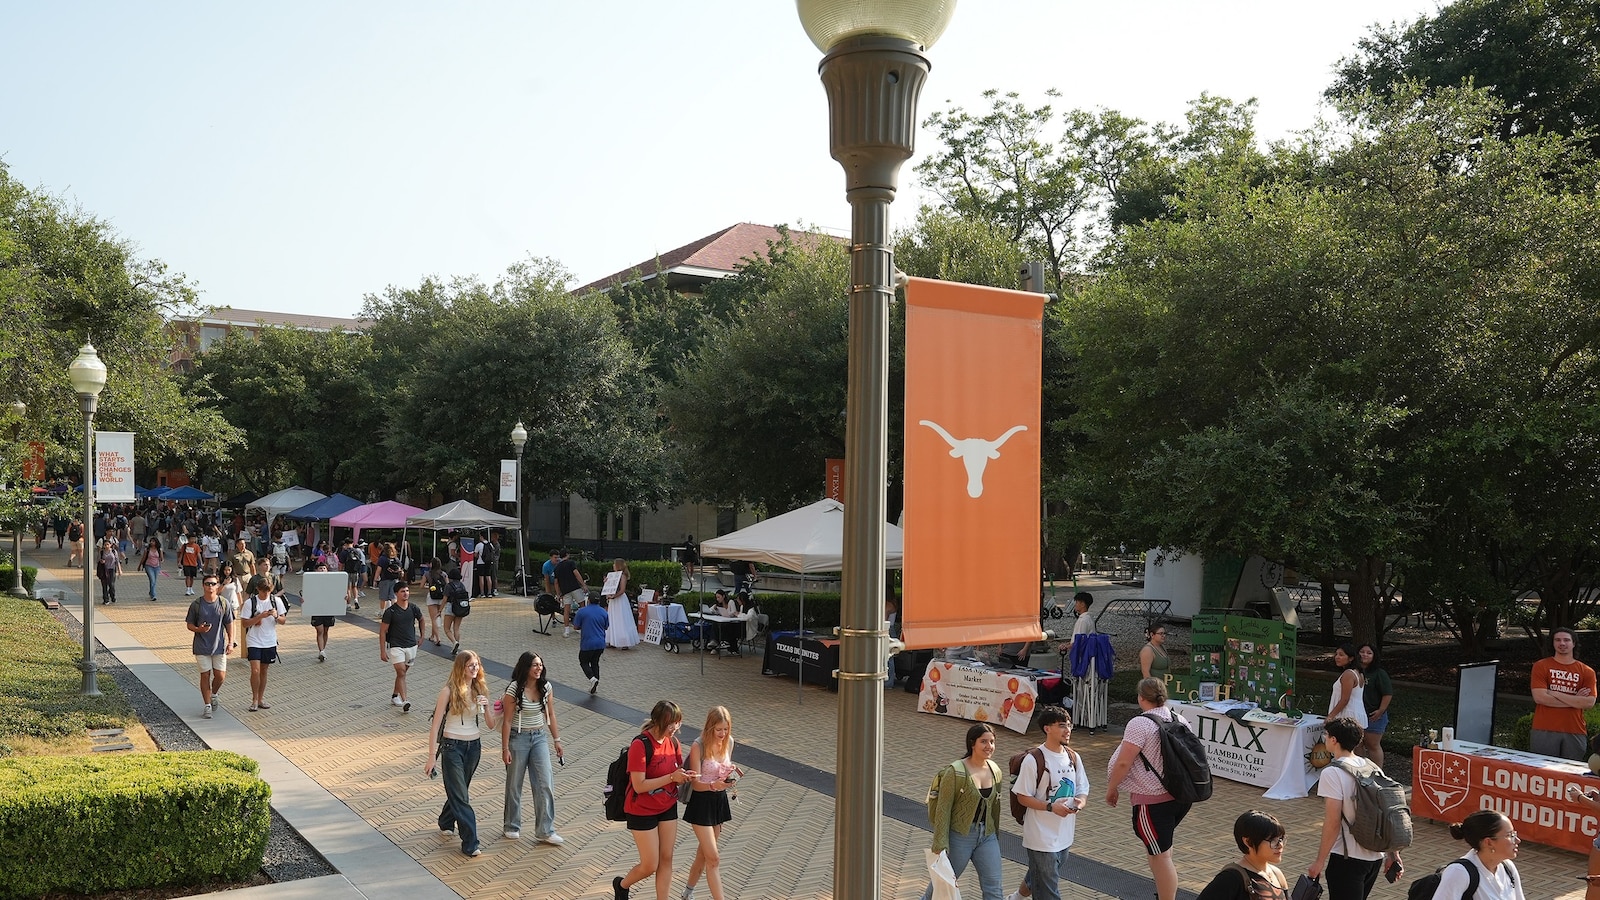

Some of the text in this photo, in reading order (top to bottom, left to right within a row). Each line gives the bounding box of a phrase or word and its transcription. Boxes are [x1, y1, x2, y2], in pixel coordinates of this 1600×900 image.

[776, 643, 794, 653] TEXAS
[963, 675, 982, 683] Market
[1549, 669, 1580, 682] TEXAS
[1207, 745, 1264, 765] LAMBDA CHI
[1212, 763, 1230, 772] MARCH
[1249, 764, 1263, 773] INC.
